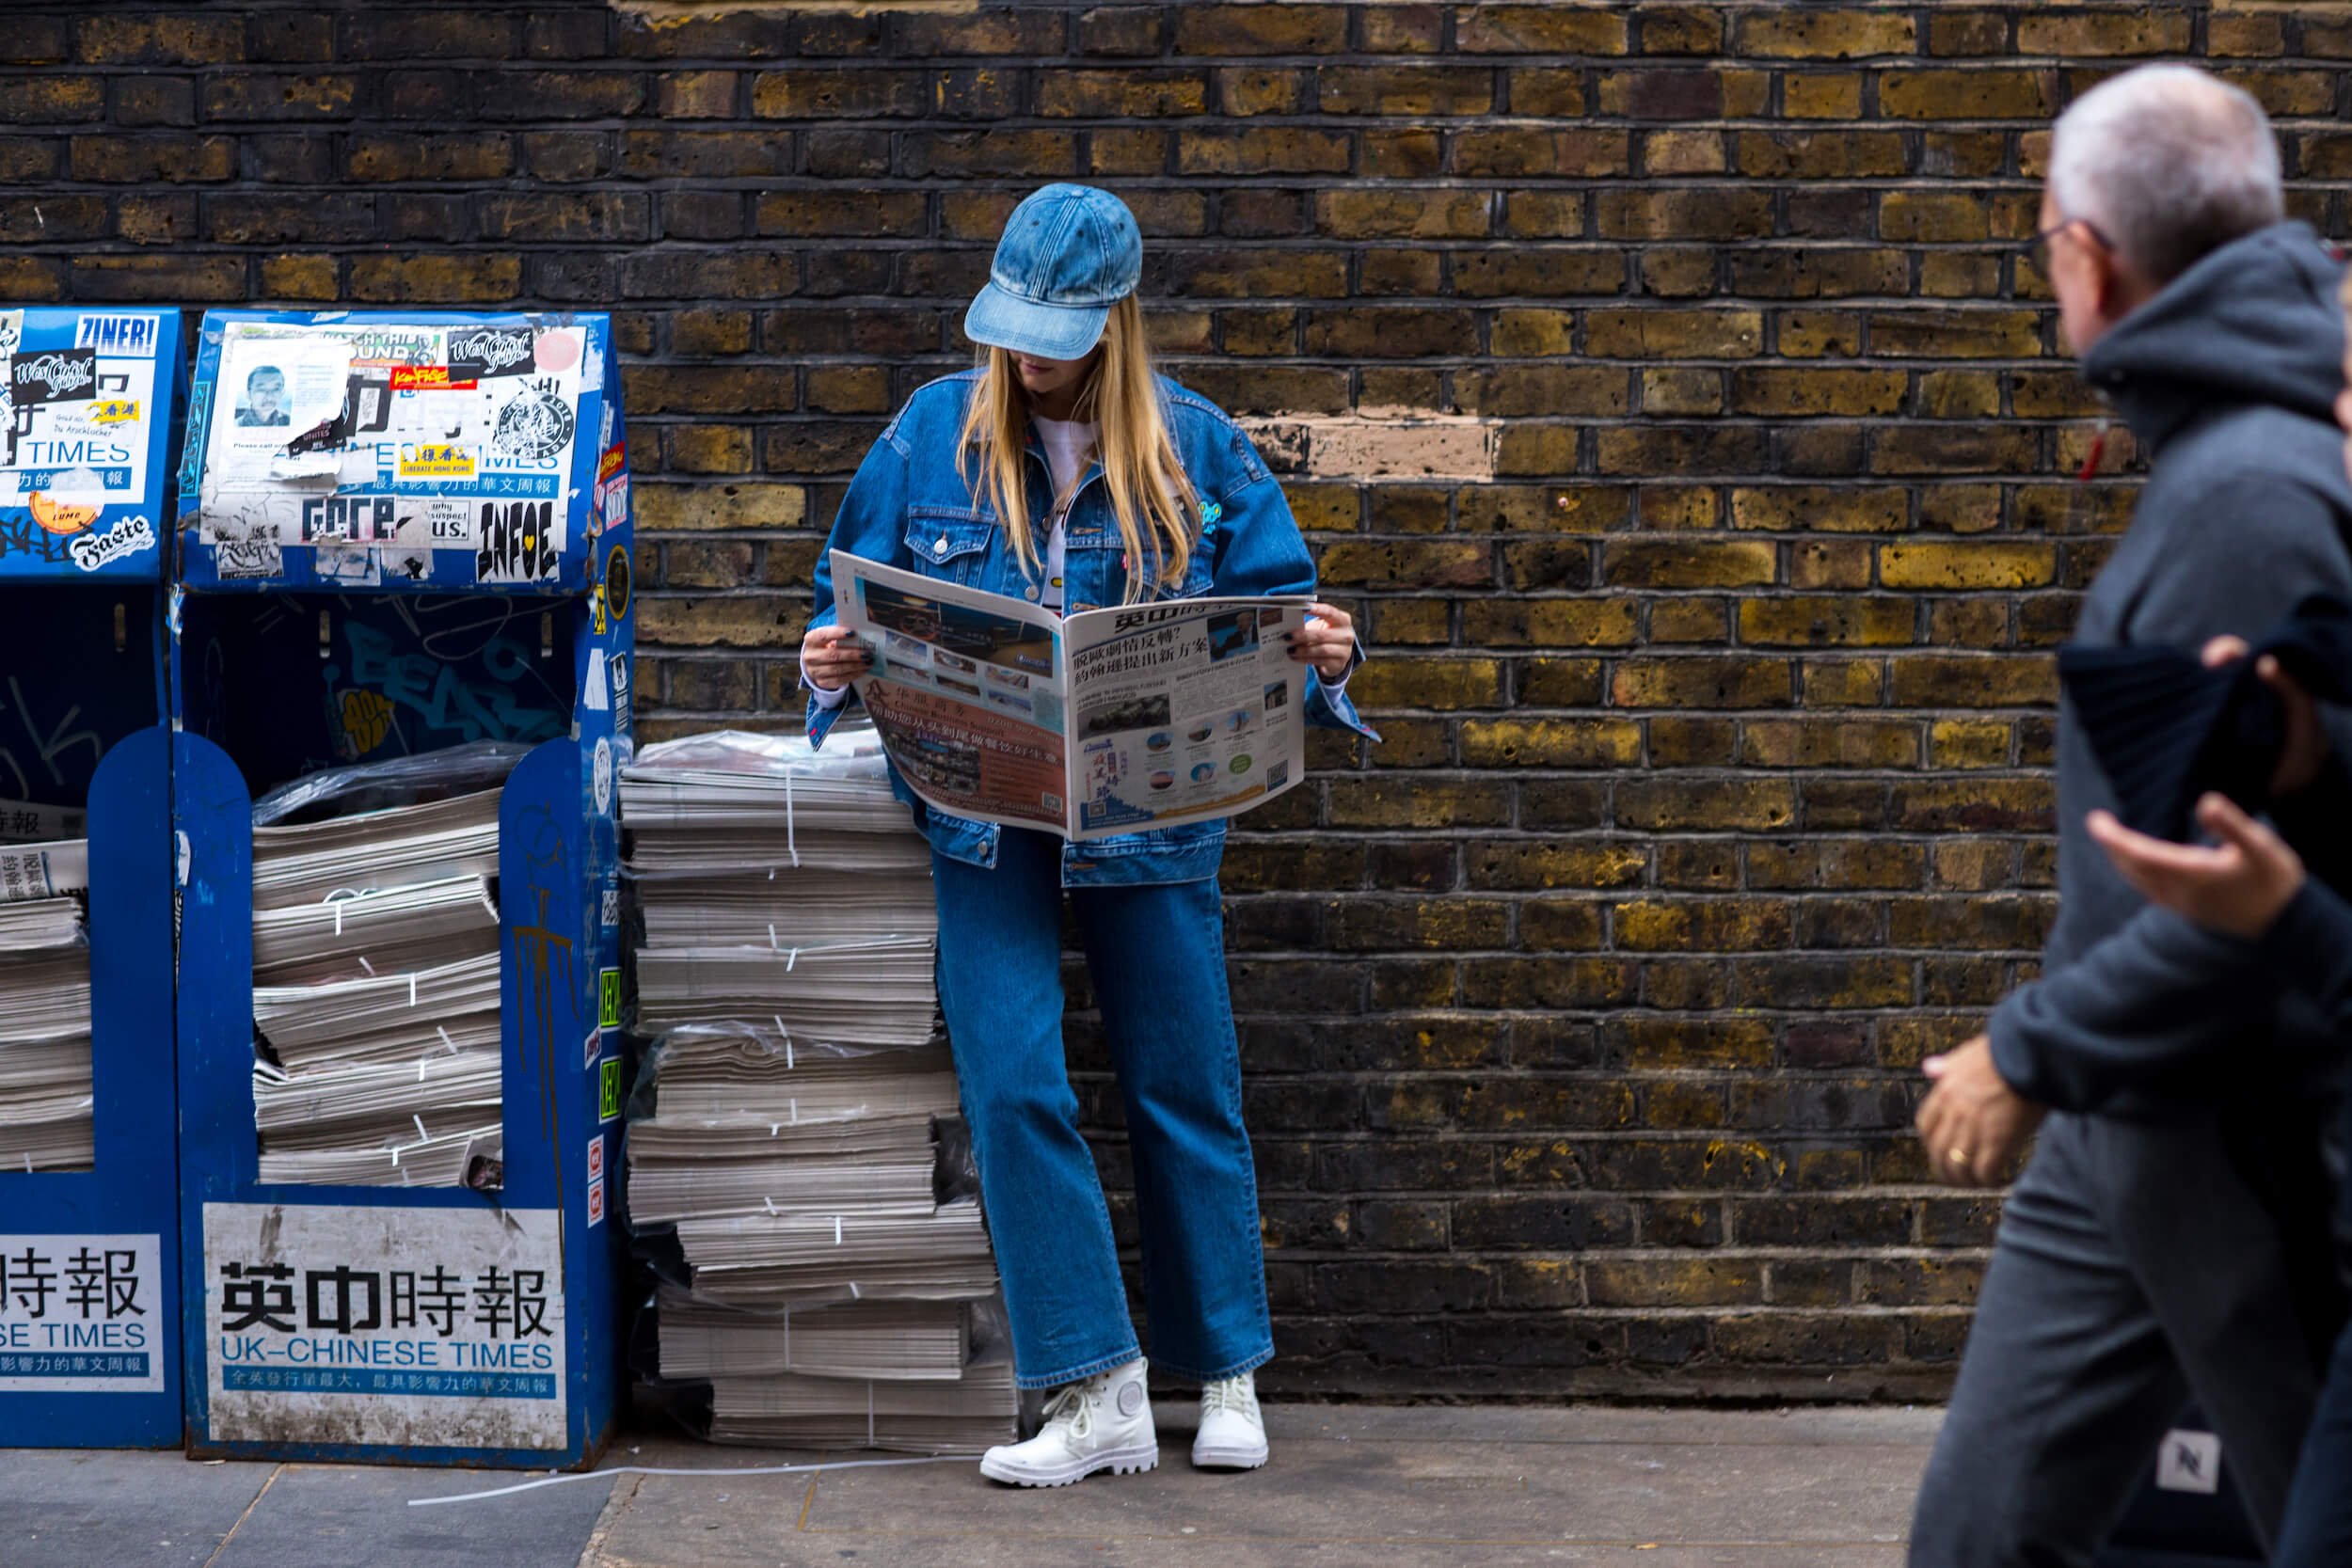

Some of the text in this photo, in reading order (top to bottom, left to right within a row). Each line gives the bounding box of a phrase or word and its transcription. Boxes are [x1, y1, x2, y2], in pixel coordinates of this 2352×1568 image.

[26, 440, 130, 465] TIMES
[431, 502, 453, 513] why
[432, 521, 467, 537] us.
[220, 1262, 554, 1339] 英中時報
[40, 1323, 146, 1348] TIMES
[449, 1342, 552, 1370] TIMES
